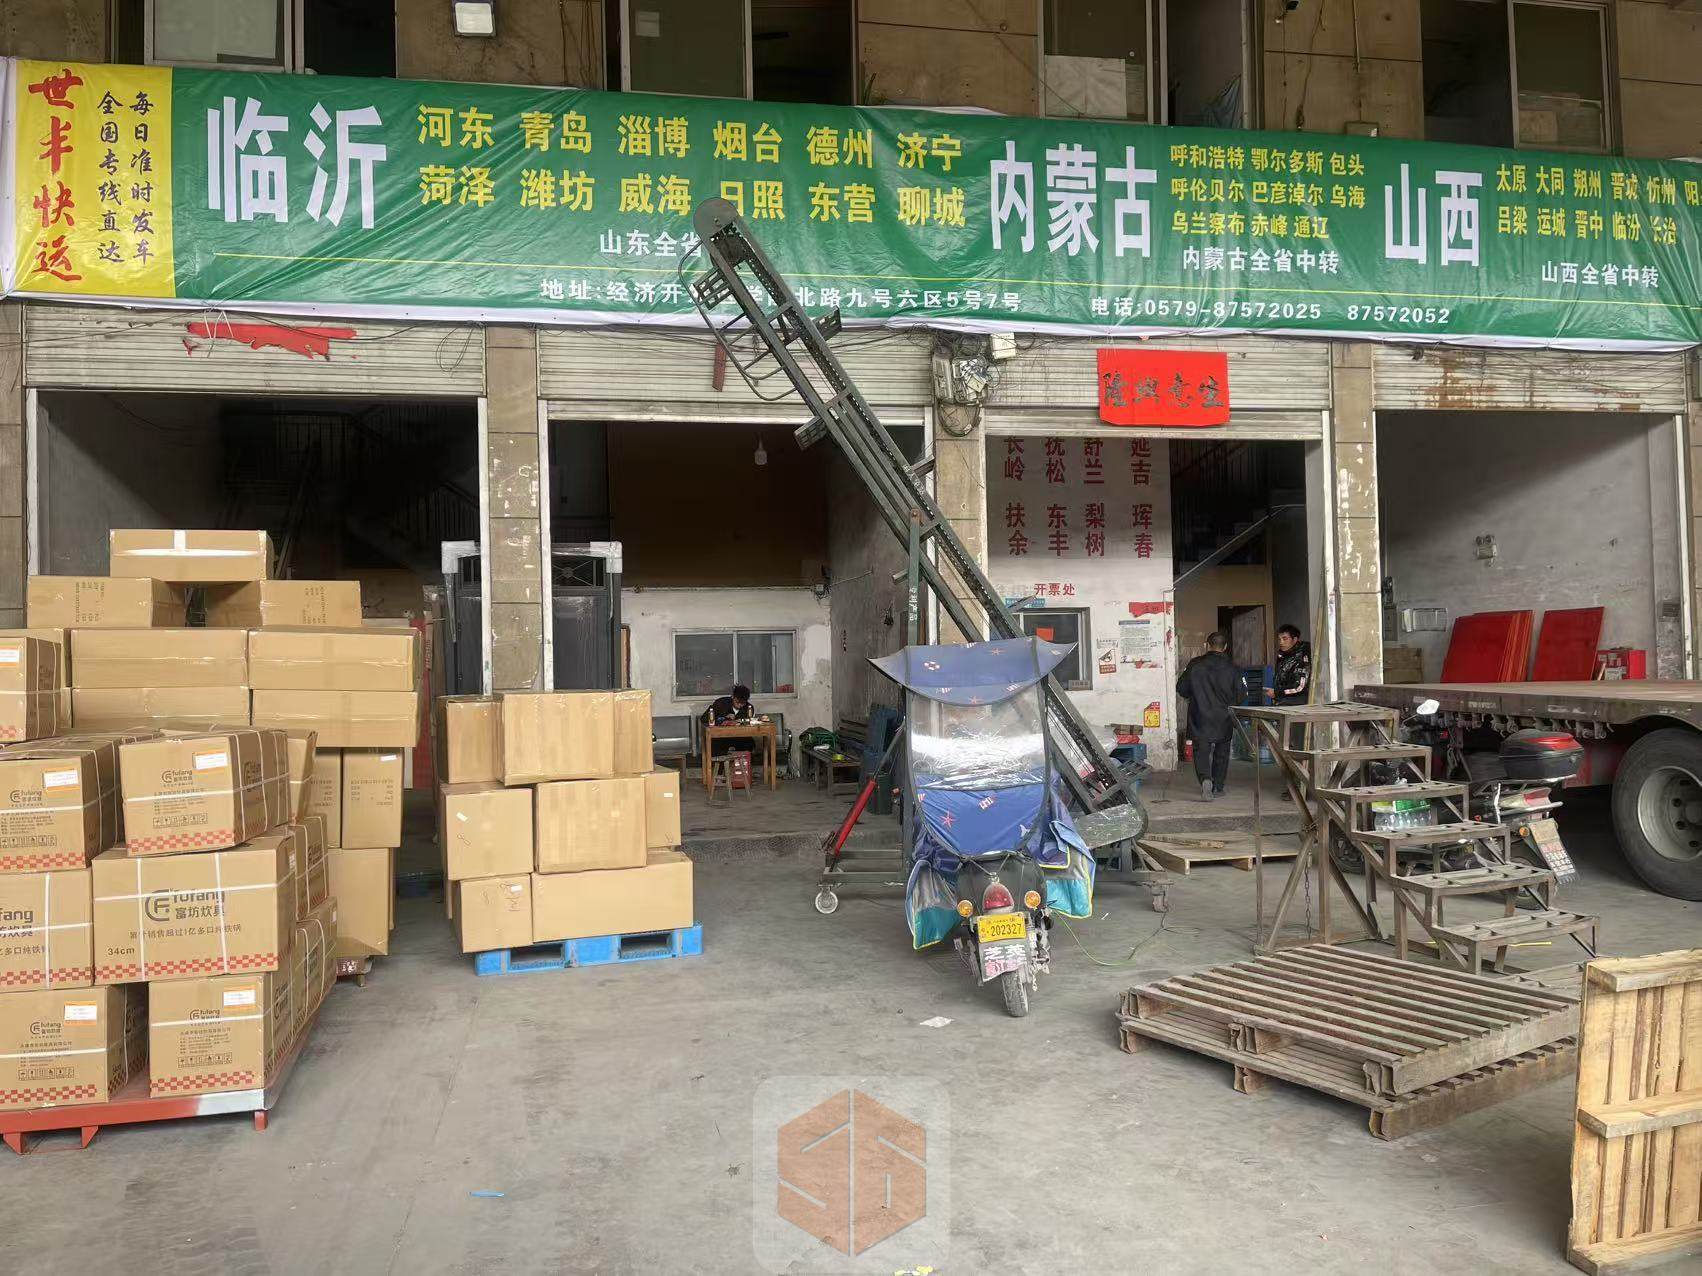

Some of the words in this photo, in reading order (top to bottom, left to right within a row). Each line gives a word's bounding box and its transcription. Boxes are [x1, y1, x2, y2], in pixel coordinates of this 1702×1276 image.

[417, 104, 496, 149] 河东
[519, 110, 592, 154] 青岛
[617, 114, 691, 158] 淄博
[712, 120, 783, 164] 烟台
[806, 126, 873, 168] 德州
[897, 132, 962, 172] 济宁
[98, 91, 124, 263] 全国专线直达
[129, 91, 154, 265] 每日准时发车
[207, 96, 387, 229] 临沂
[1170, 144, 1245, 171] 呼和浩特
[1250, 148, 1324, 176] 鄂尔多斯
[1330, 152, 1365, 177] 包头
[419, 165, 496, 207] 菏泽
[519, 168, 595, 212] 潍坊
[618, 173, 692, 217] 威海
[720, 180, 785, 220] 日照
[808, 181, 876, 223] 东营
[897, 186, 966, 227] 聊城
[990, 141, 1157, 257] 内蒙古
[1170, 178, 1245, 203] 呼伦贝尔
[1251, 180, 1324, 206] 巴彦淖尔
[1330, 183, 1366, 209] 乌海
[1496, 164, 1527, 193] 太原
[1535, 166, 1565, 196] 大同
[1573, 168, 1602, 199] 朔州
[1610, 172, 1639, 201] 晋城
[1684, 181, 1702, 206] 阳
[1171, 211, 1245, 236] 乌兰察布
[1251, 213, 1288, 239] 赤峰
[1293, 215, 1329, 240] 通辽
[1385, 163, 1483, 267] 山西
[1498, 206, 1528, 235] 吕梁
[1537, 207, 1566, 238] 运城
[1575, 210, 1603, 239] 晋中
[1612, 212, 1641, 241] 临汾
[1650, 215, 1677, 245] 长治
[1183, 245, 1339, 275] 内蒙古全省中转
[1541, 261, 1659, 288] 山西全省中转
[1091, 296, 1321, 320] 电话:0579-87572025
[1348, 305, 1449, 324] 87572052
[1004, 438, 1025, 482] 长岭
[1006, 502, 1028, 556] 扶余
[1046, 504, 1069, 556] 东丰
[1085, 502, 1105, 556] 梨树
[1132, 504, 1154, 559] 珲春
[1034, 583, 1077, 597] 开票处
[108, 947, 135, 956] 34cm
[991, 923, 1022, 937] 202327
